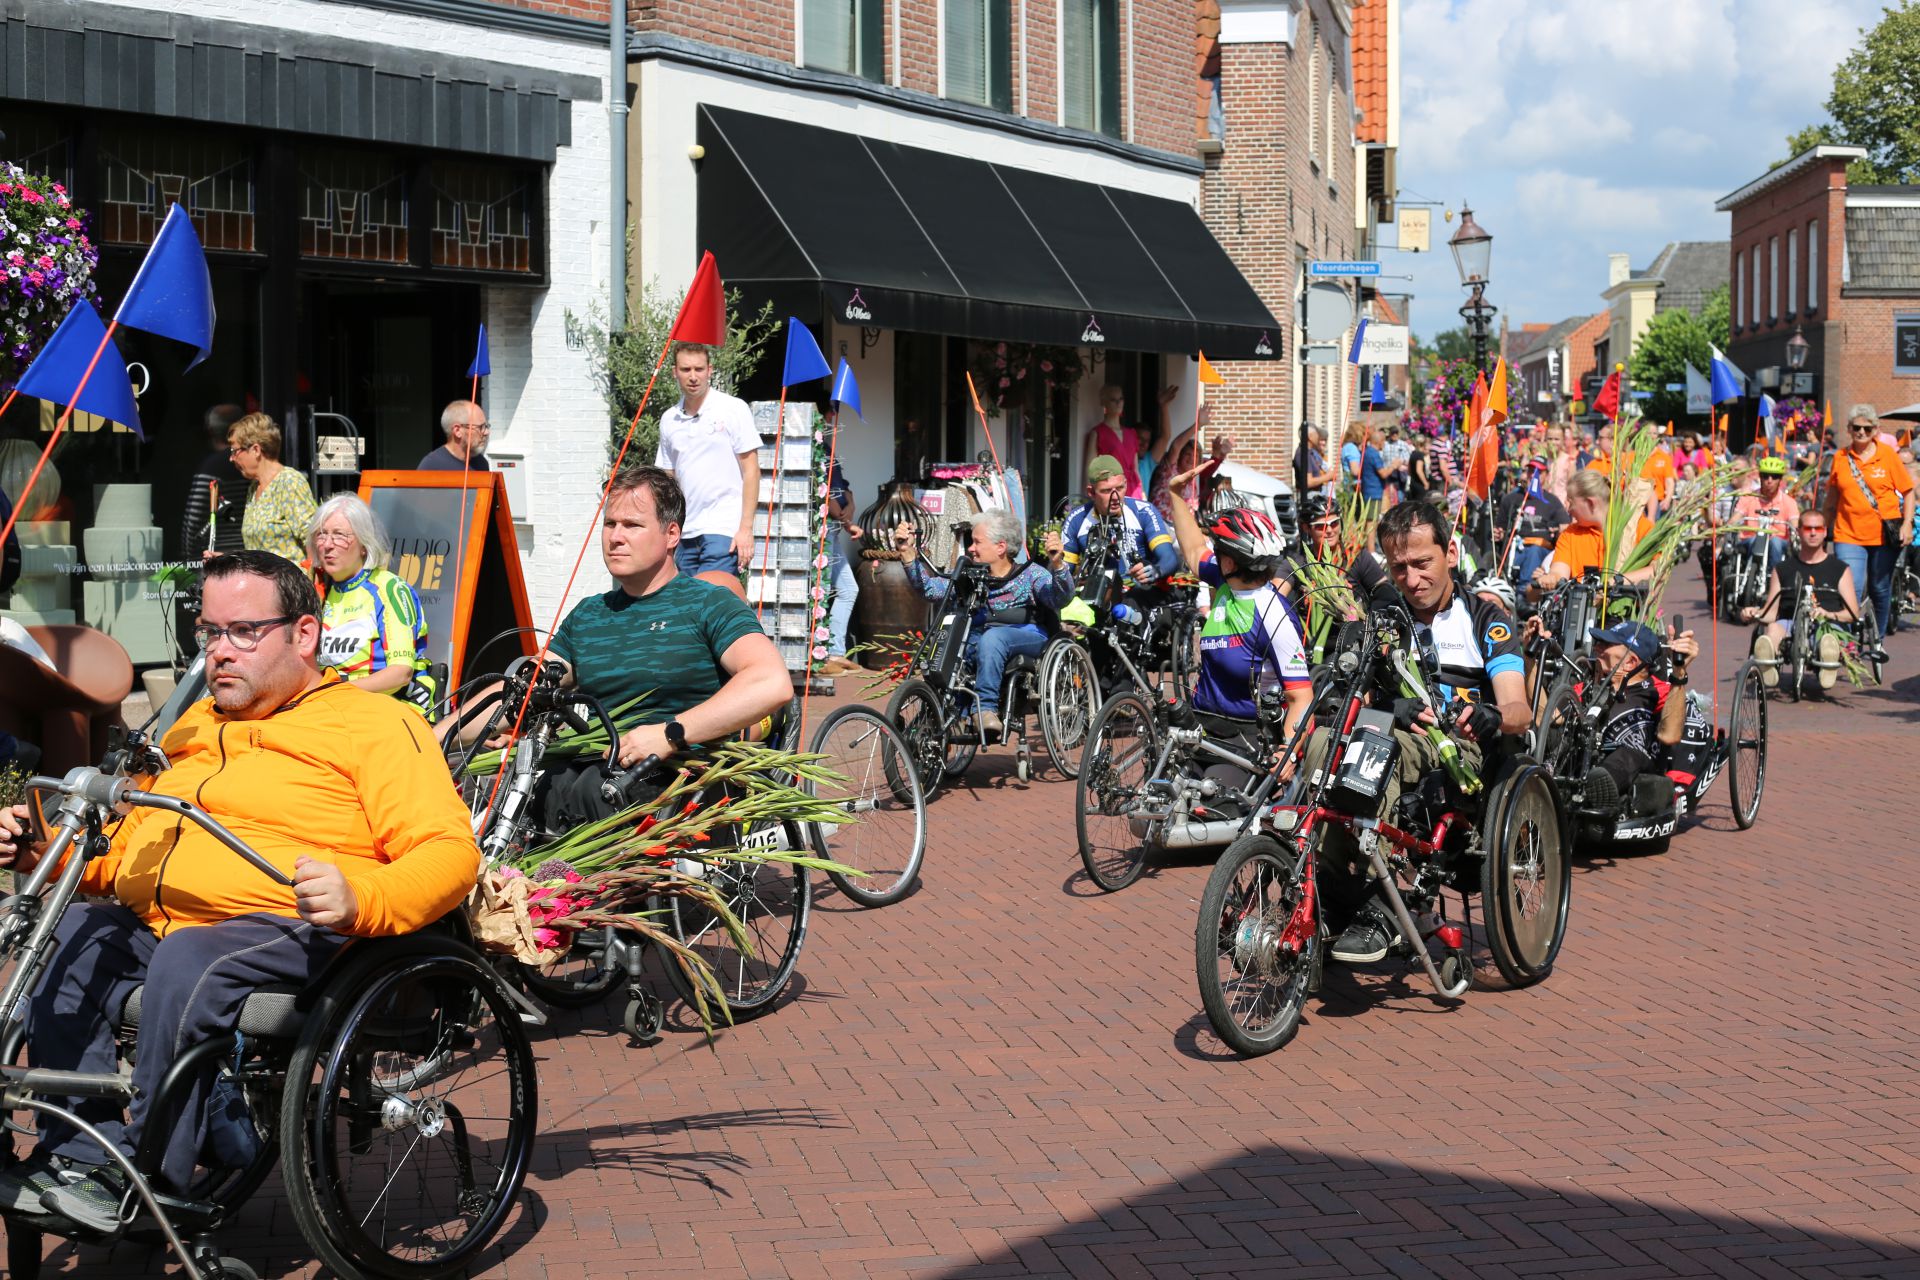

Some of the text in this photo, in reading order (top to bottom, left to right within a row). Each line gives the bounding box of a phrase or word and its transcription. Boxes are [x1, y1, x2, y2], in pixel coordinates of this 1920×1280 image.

[1316, 263, 1376, 275] Noorderhagen
[390, 537, 451, 558] TUDIO
[1341, 776, 1373, 793] STRICKER
